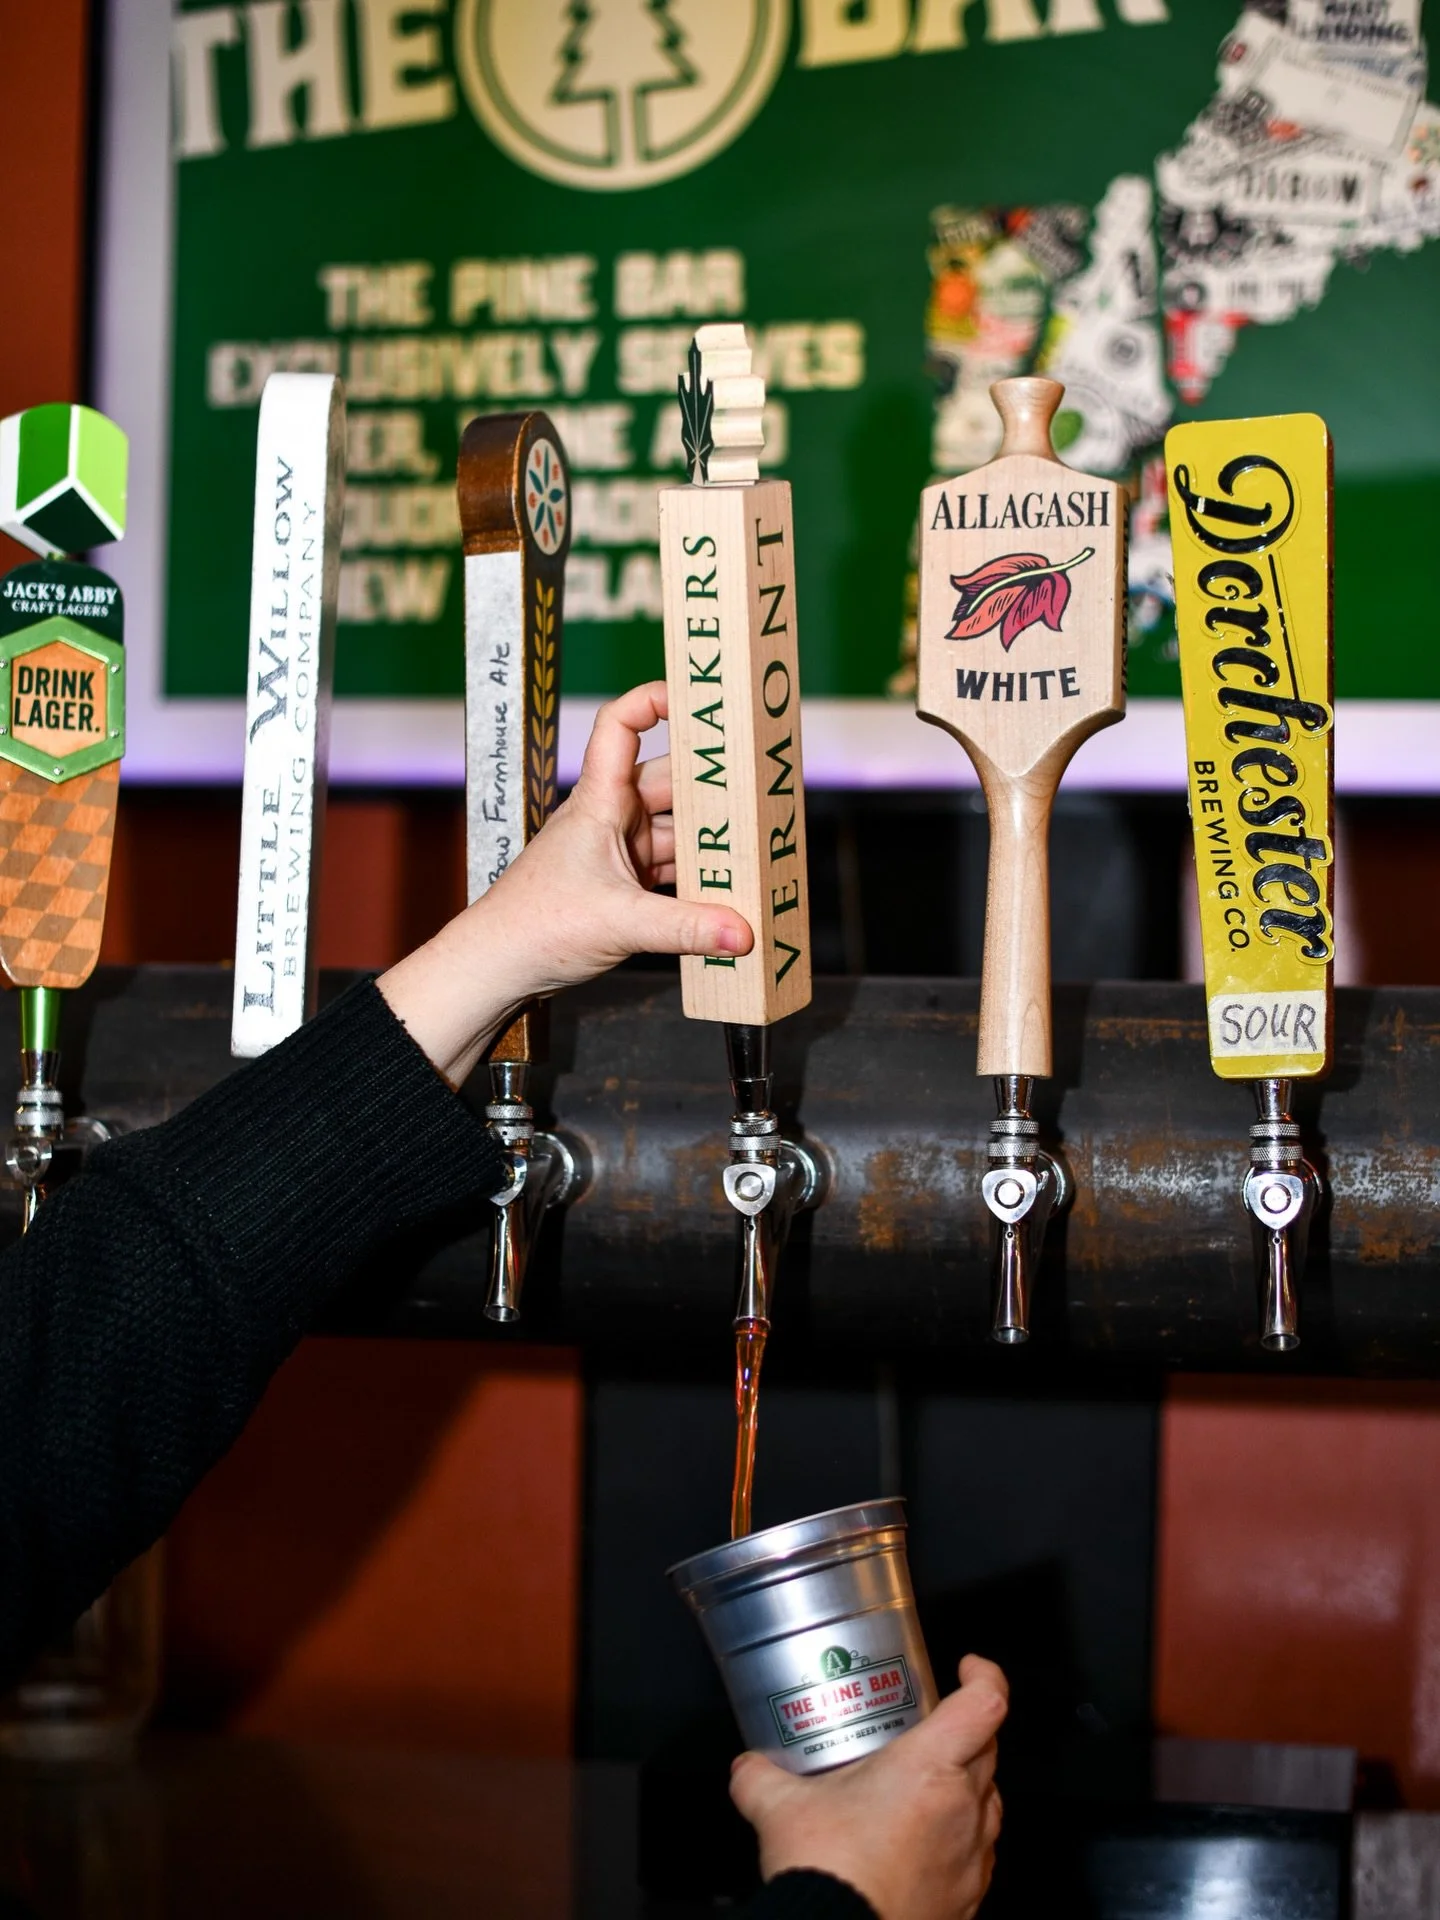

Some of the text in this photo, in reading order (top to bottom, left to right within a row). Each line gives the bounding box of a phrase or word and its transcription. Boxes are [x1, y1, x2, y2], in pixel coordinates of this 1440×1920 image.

[172, 0, 457, 158] THE
[318, 248, 745, 330] THE PINE BAR
[931, 490, 1110, 530] ALLAGASH
[3, 580, 118, 604] JACK'S ABBY
[11, 599, 109, 617] CRAFT LAGERS
[18, 665, 94, 700] DRINK
[489, 642, 511, 686] Ale
[683, 535, 729, 792] MAKERS
[956, 667, 1081, 702] WHITE
[14, 697, 101, 733] LAGER.
[243, 456, 293, 1016] LITTLE WILLOW
[283, 501, 317, 976] BREWING COMPANY
[1174, 455, 1329, 958] Dorchester
[482, 701, 509, 823] Farmhouse
[756, 517, 801, 991] VERMONT
[1194, 761, 1251, 952] BREWING CO.
[1222, 1003, 1317, 1052] SOUR
[782, 1698, 814, 1718] THE
[869, 1670, 901, 1691] BAR
